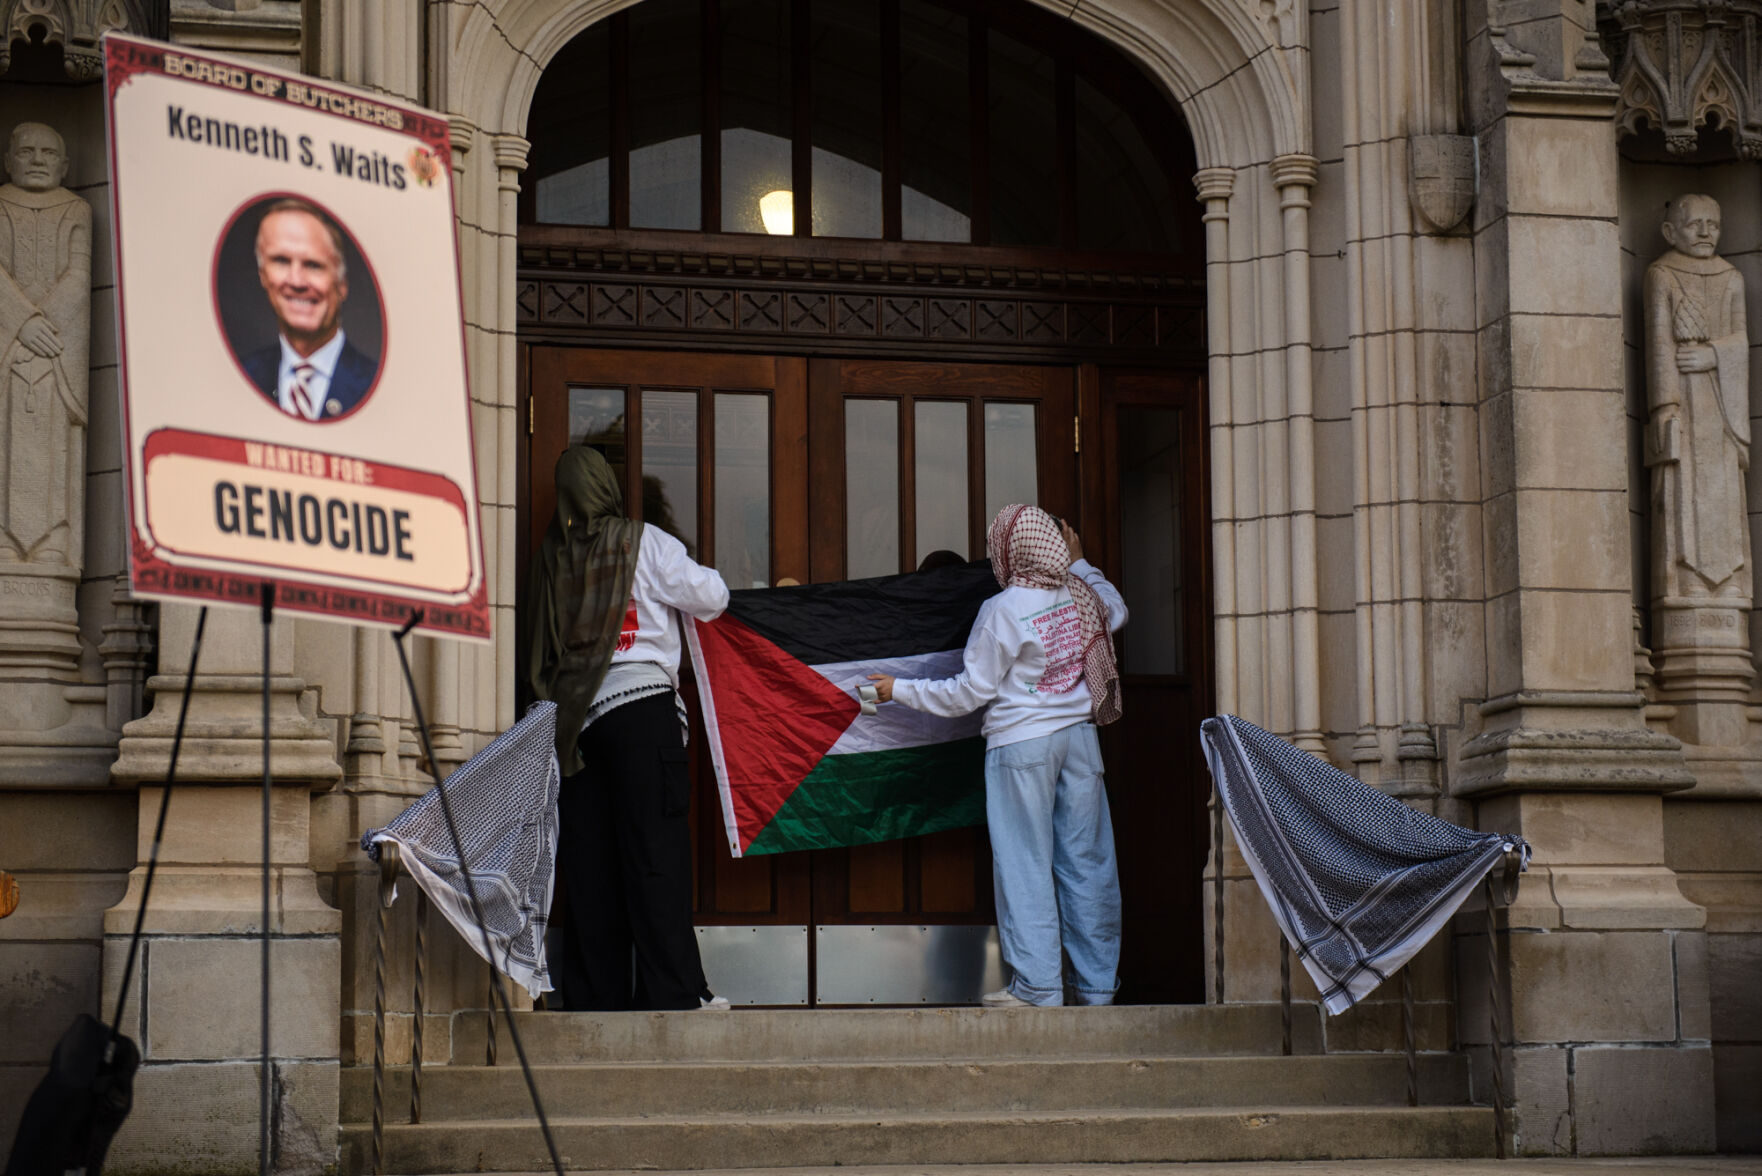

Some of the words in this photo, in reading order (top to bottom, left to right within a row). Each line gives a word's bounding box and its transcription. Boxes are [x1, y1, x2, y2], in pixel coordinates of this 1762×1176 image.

[164, 53, 248, 91] BOARD
[251, 73, 286, 98] OF
[286, 81, 405, 131] BUTCHERS
[168, 105, 289, 163] Kenneth
[298, 135, 323, 171] S.
[331, 142, 408, 191] Waits
[244, 442, 327, 479] WANTED
[329, 456, 375, 486] FOR:
[214, 480, 415, 563] GENOCIDE
